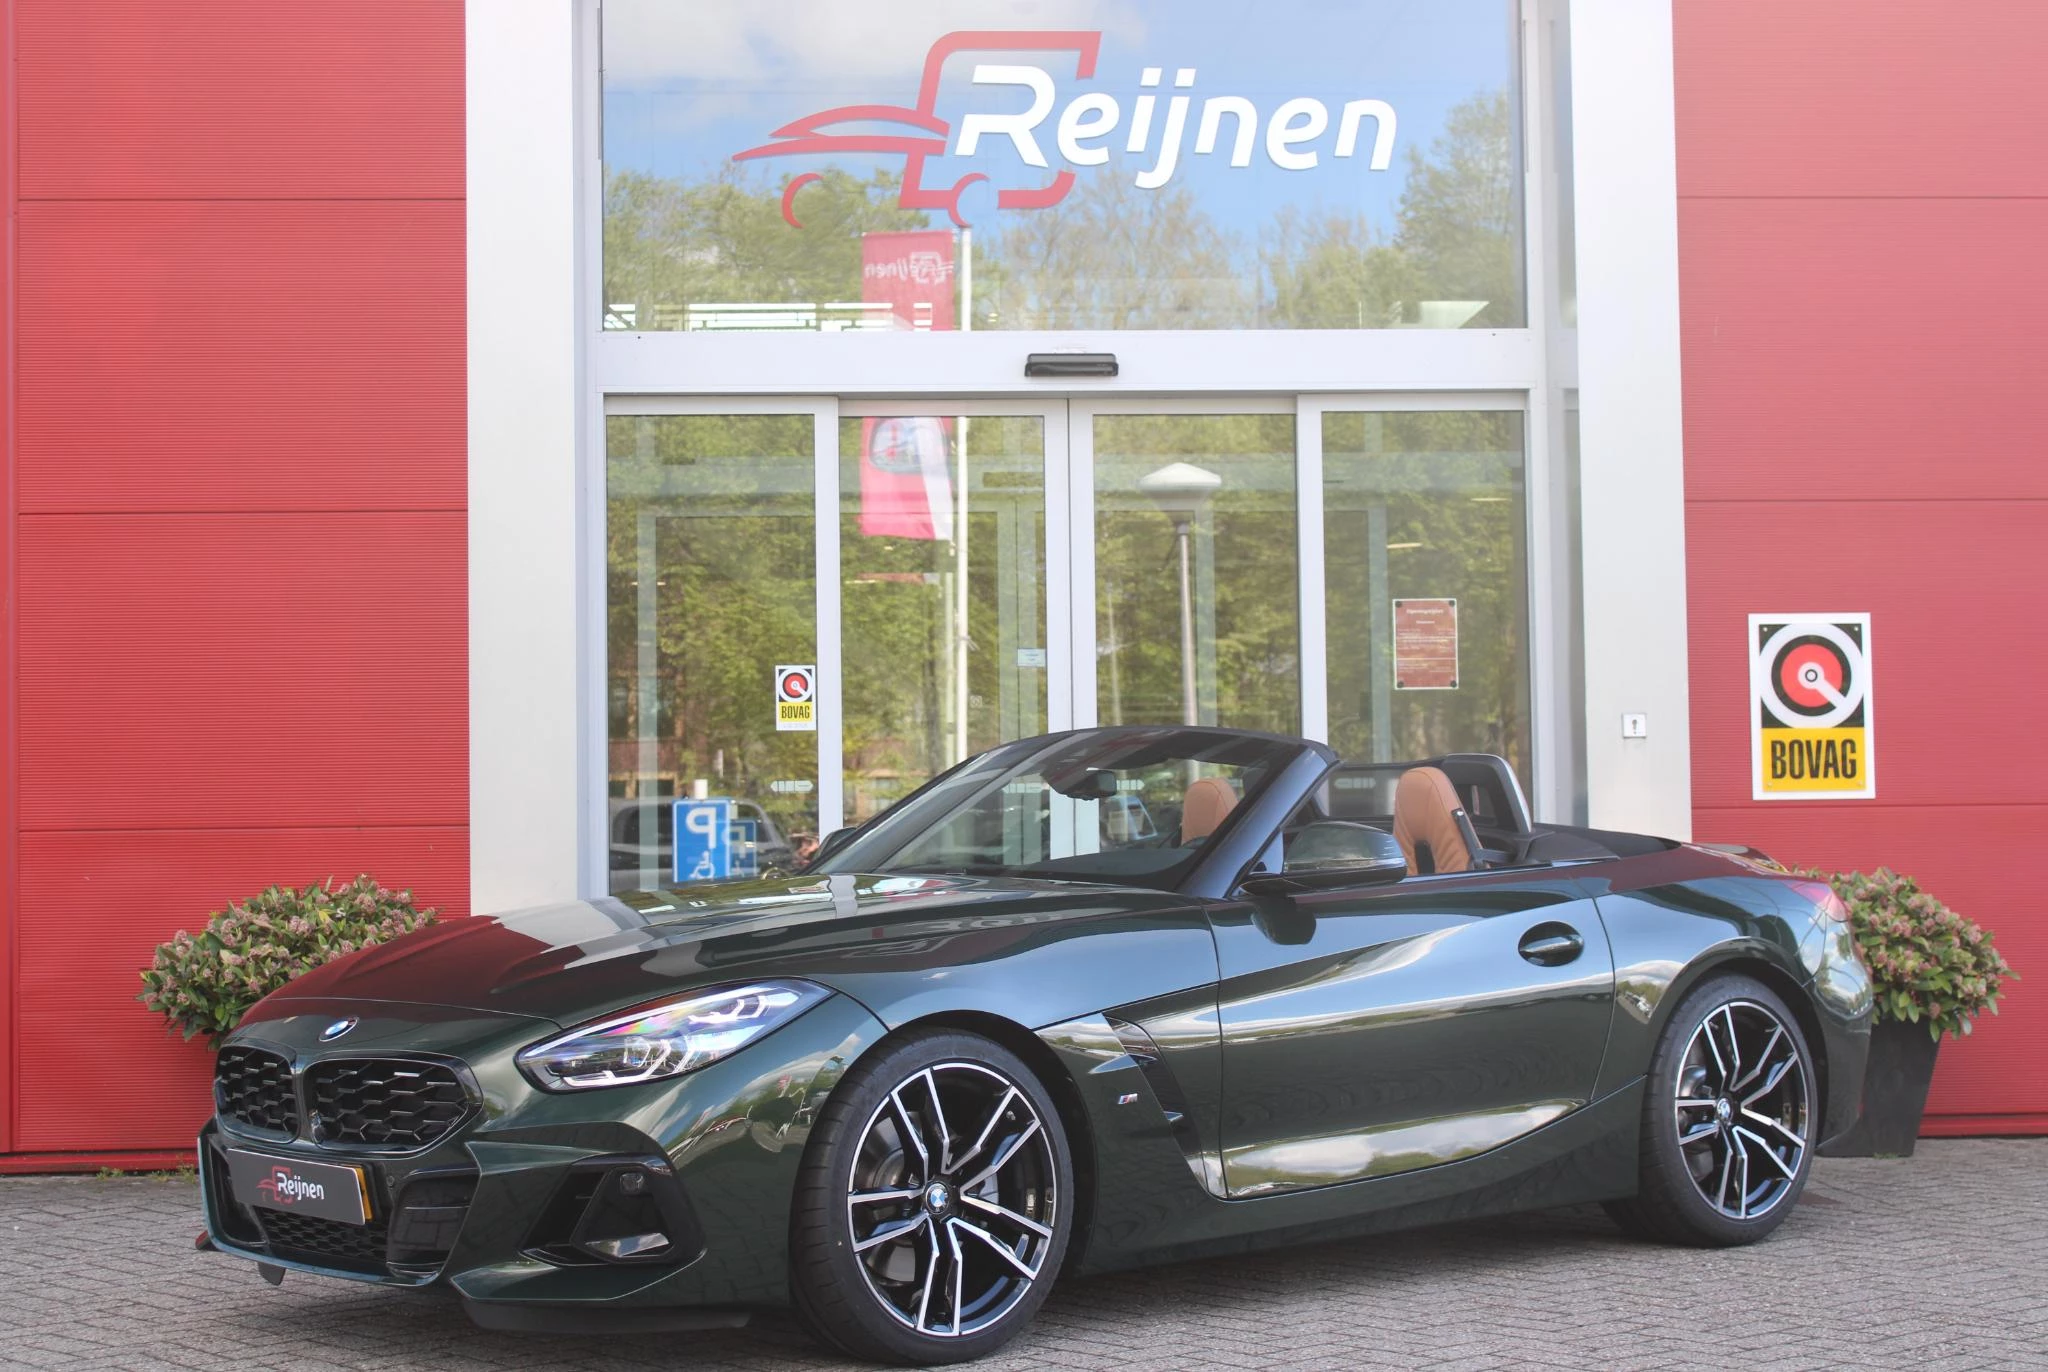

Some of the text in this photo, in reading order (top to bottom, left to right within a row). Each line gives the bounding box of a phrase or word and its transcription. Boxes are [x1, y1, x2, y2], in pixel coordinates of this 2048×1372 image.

[955, 65, 1398, 189] Reijnen
[781, 705, 810, 719] BOVAG
[1770, 738, 1857, 779] BOVAG
[277, 1172, 325, 1200] Reijnen
